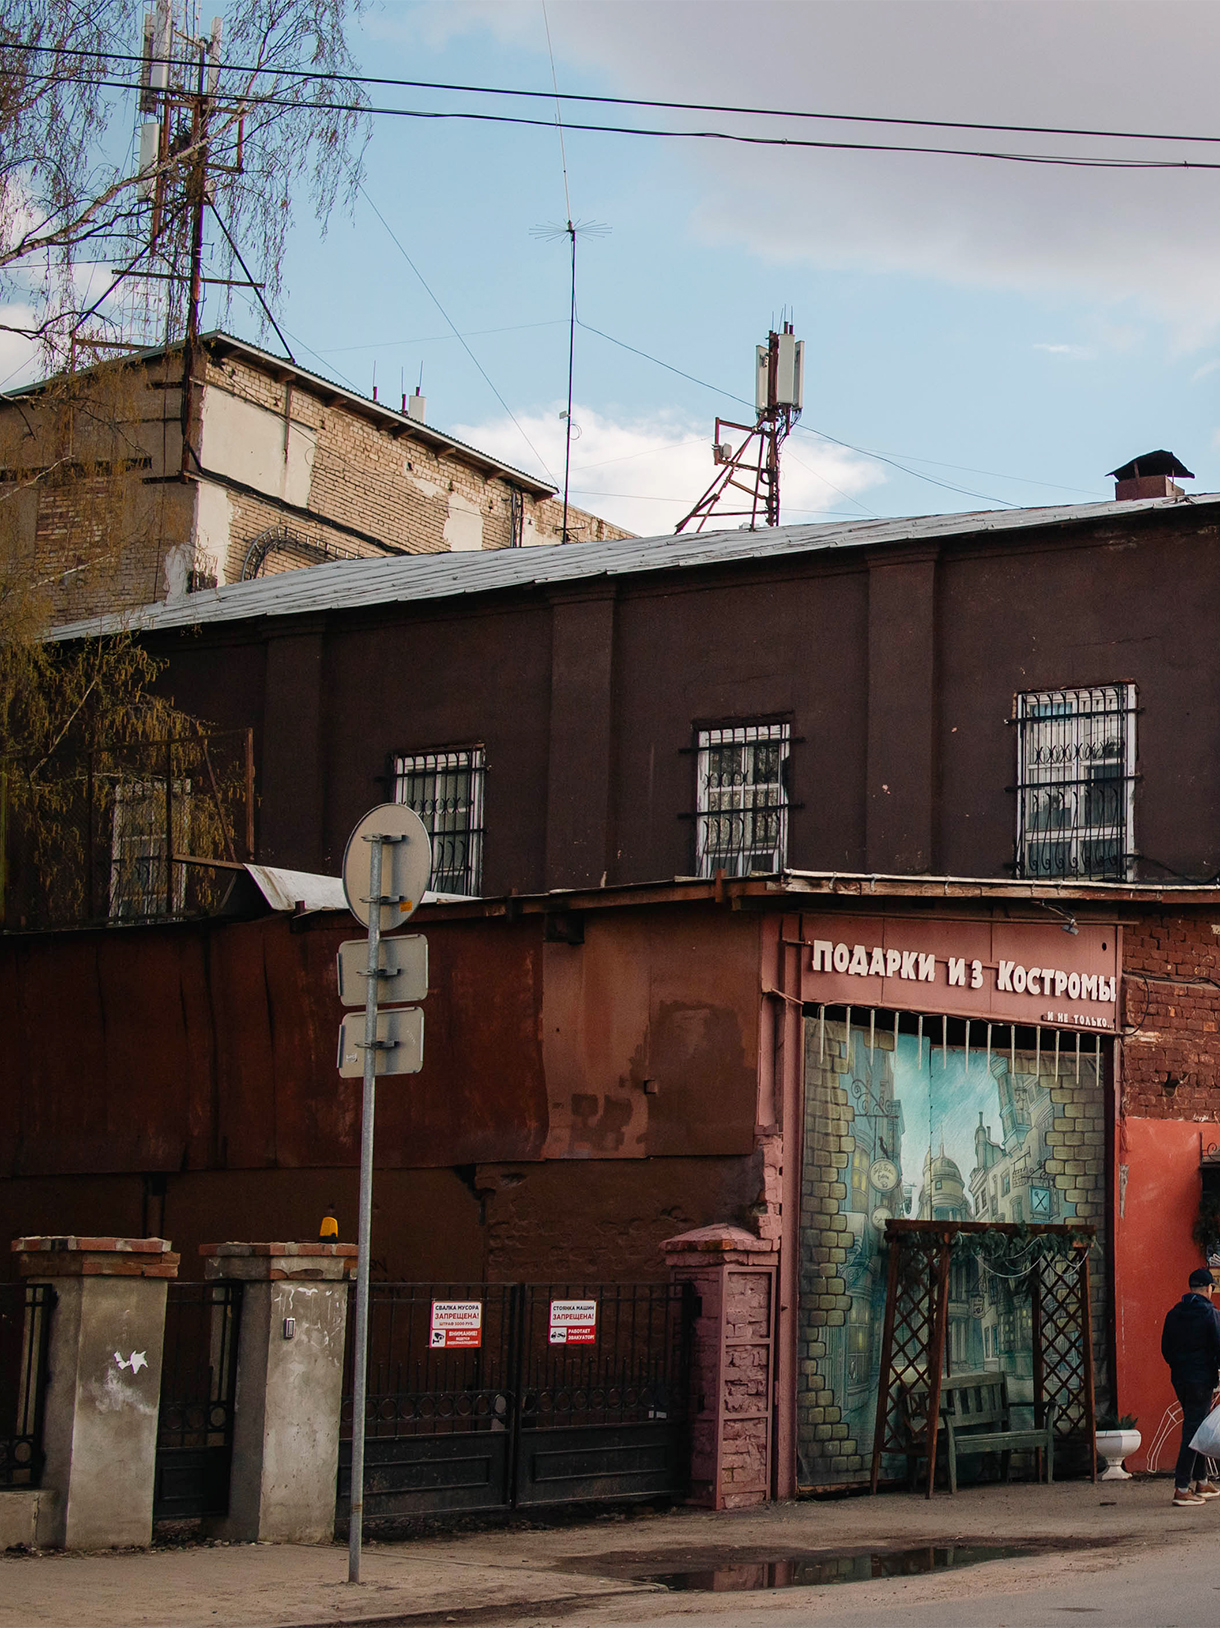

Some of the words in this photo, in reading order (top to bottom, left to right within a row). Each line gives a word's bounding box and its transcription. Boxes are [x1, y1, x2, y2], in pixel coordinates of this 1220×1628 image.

[812, 940, 936, 981] ПОДАРКИ
[948, 957, 984, 989] ИЗ
[997, 960, 1117, 1002] КОСТРОМЫ
[1047, 1011, 1054, 1021] И
[1057, 1012, 1068, 1023] НЕ
